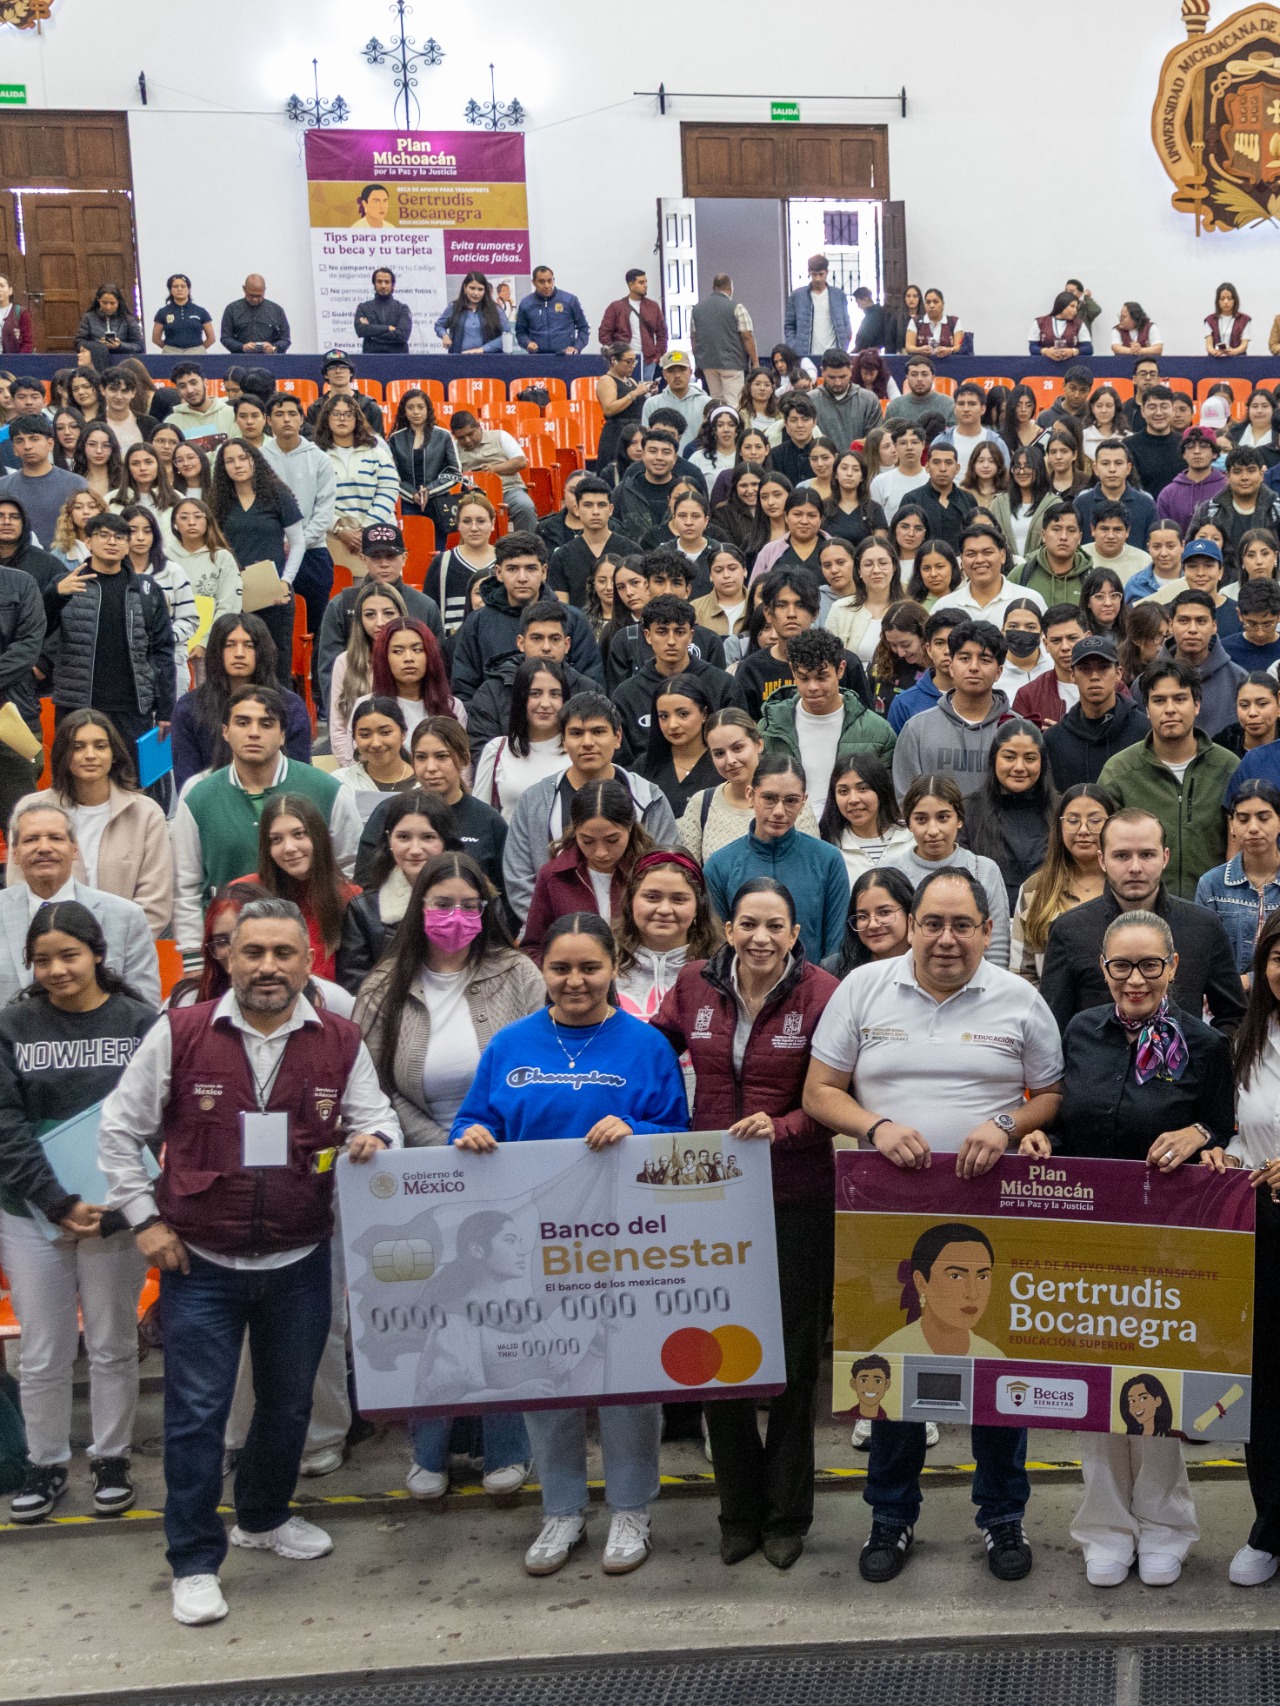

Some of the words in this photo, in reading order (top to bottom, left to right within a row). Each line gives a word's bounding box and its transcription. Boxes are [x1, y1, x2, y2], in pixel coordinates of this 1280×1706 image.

[0, 90, 25, 98] ALIDA
[1162, 77, 1185, 164] UNIVERSIDAD
[1178, 20, 1260, 75] MICHOACANA
[1260, 18, 1276, 33] DE
[397, 138, 431, 152] Plan
[373, 151, 457, 166] Michoacán
[389, 167, 396, 175] la
[398, 168, 411, 176] Paz
[419, 168, 427, 176] la
[428, 168, 457, 176] Justicia
[397, 192, 474, 207] Gertrudis
[398, 206, 482, 223] Bocanegra
[324, 232, 348, 242] Tips
[351, 234, 377, 242] para
[380, 233, 430, 243] proteger
[323, 246, 336, 255] tu
[339, 244, 365, 255] beca
[368, 247, 376, 256] y
[380, 246, 392, 255] tu
[395, 245, 433, 257] tarjeta
[451, 240, 475, 250] Evita
[476, 243, 515, 251] rumores
[516, 243, 524, 253] y
[453, 253, 490, 263] noticias
[491, 253, 522, 264] falsas.
[340, 265, 376, 273] compartas
[284, 382, 294, 391] 36
[471, 381, 482, 391] 33
[443, 404, 453, 415] 33
[505, 404, 515, 415] 32
[569, 403, 579, 413] 31
[544, 421, 555, 432] 30
[937, 747, 988, 772] PUM
[973, 1033, 1015, 1046] EDUCACIÓN
[506, 1065, 627, 1091] Champion
[194, 1087, 223, 1096] México
[402, 1171, 451, 1181] Gobierno
[452, 1169, 465, 1178] de
[1028, 1165, 1067, 1181] Plan
[403, 1179, 465, 1196] México
[1000, 1180, 1094, 1199] Michoacán
[1000, 1200, 1015, 1208] por
[1027, 1200, 1042, 1208] Paz
[1044, 1202, 1050, 1210] y
[1051, 1201, 1059, 1209] la
[1061, 1201, 1094, 1211] Justicia
[540, 1221, 620, 1240] Banco
[628, 1214, 667, 1235] del
[542, 1239, 753, 1276] Bienestar
[1011, 1258, 1041, 1269] BECA
[1044, 1260, 1060, 1271] DE
[1063, 1261, 1105, 1273] APOYO
[1108, 1264, 1139, 1275] PARA
[1141, 1266, 1219, 1281] TRANSPORTE
[545, 1283, 556, 1292] El
[558, 1281, 592, 1292] banco
[594, 1280, 608, 1289] de
[610, 1278, 626, 1288] los
[628, 1276, 687, 1287] mexicanos
[1009, 1271, 1182, 1311] Gertrudis
[371, 1303, 448, 1333] 0000
[466, 1297, 543, 1328] 0000
[561, 1291, 637, 1322] 0000
[655, 1285, 732, 1317] 0000
[1009, 1303, 1198, 1349] Bocanegra
[497, 1342, 519, 1351] VALID
[521, 1336, 581, 1358] 00/00
[1009, 1335, 1077, 1348] EDUCACIÓN
[1079, 1338, 1136, 1351] SUPERIOR
[497, 1350, 518, 1358] THRU
[1033, 1387, 1075, 1401] Becas
